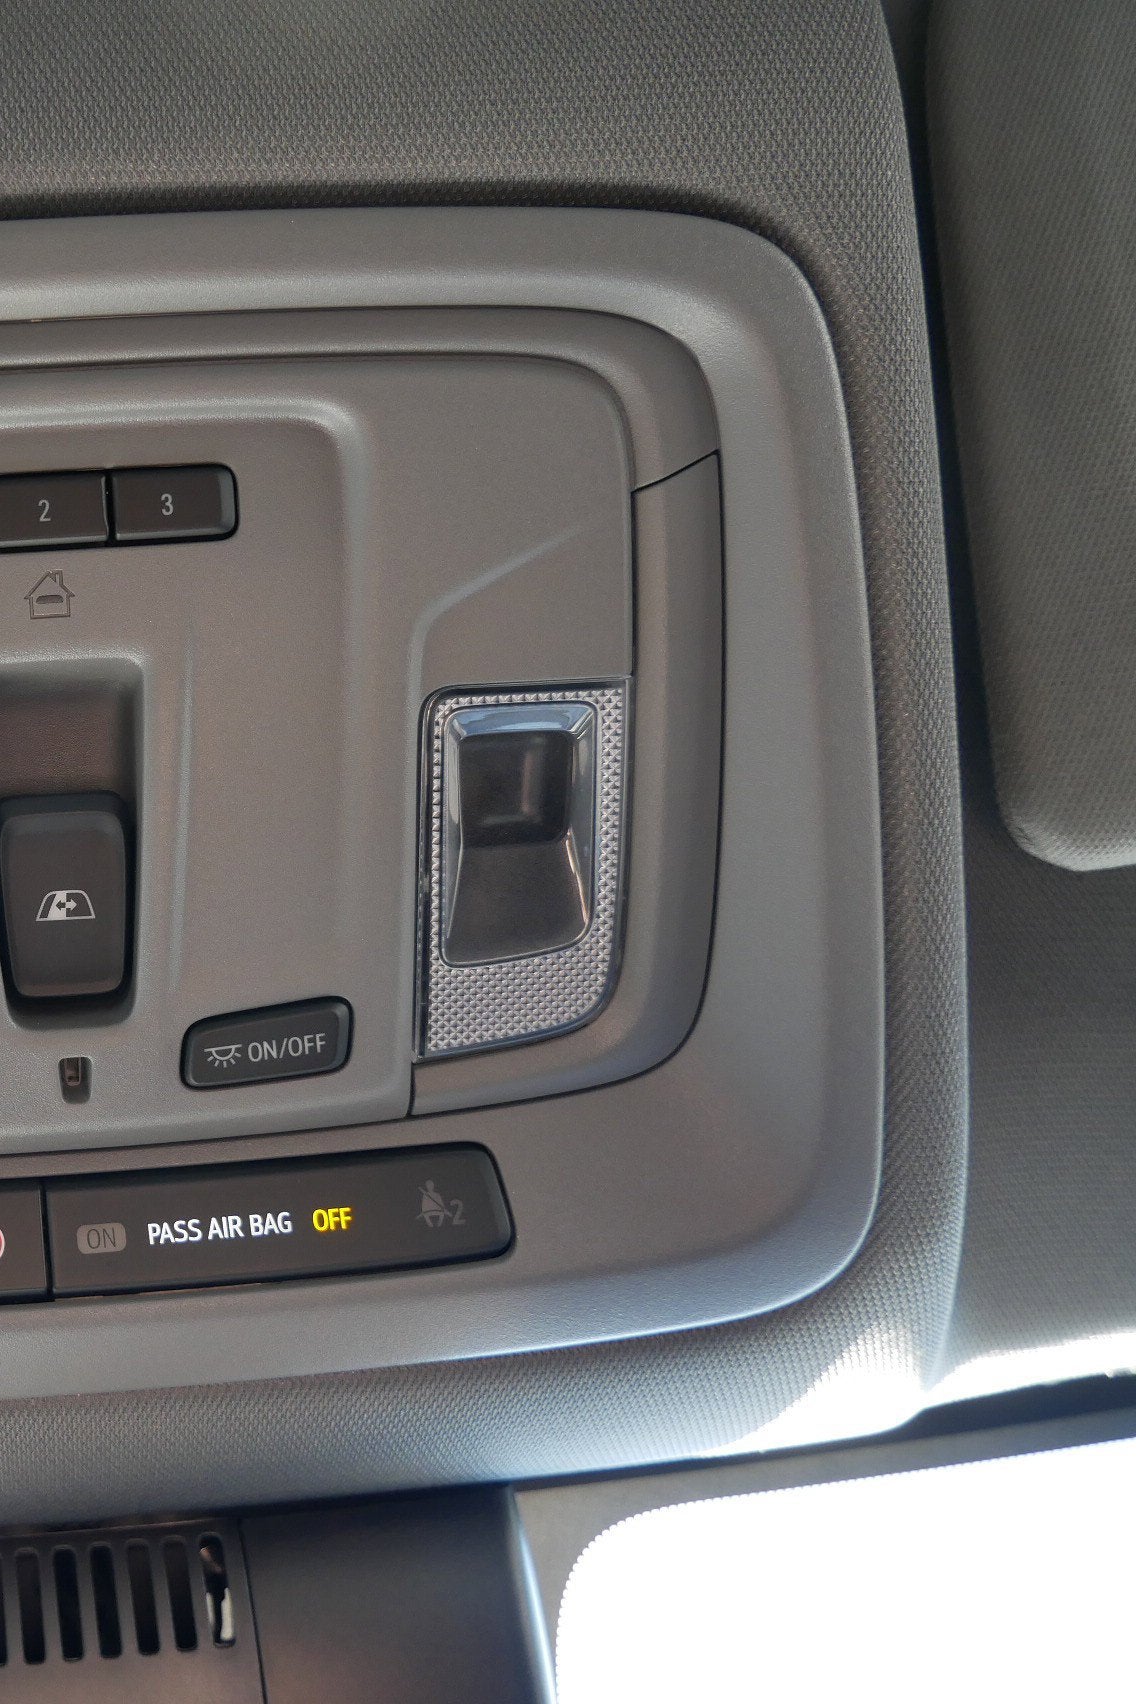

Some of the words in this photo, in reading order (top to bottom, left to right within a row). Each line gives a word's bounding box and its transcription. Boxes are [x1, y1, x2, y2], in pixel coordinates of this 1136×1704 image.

[38, 499, 51, 522] 2
[161, 493, 174, 516] 3
[247, 1033, 326, 1062] ON/OFF
[450, 1199, 464, 1225] 2
[147, 1219, 202, 1245] PASS
[208, 1215, 243, 1240] AIR
[250, 1211, 292, 1236] BAG
[312, 1207, 353, 1232] OFF
[87, 1227, 117, 1250] ON
